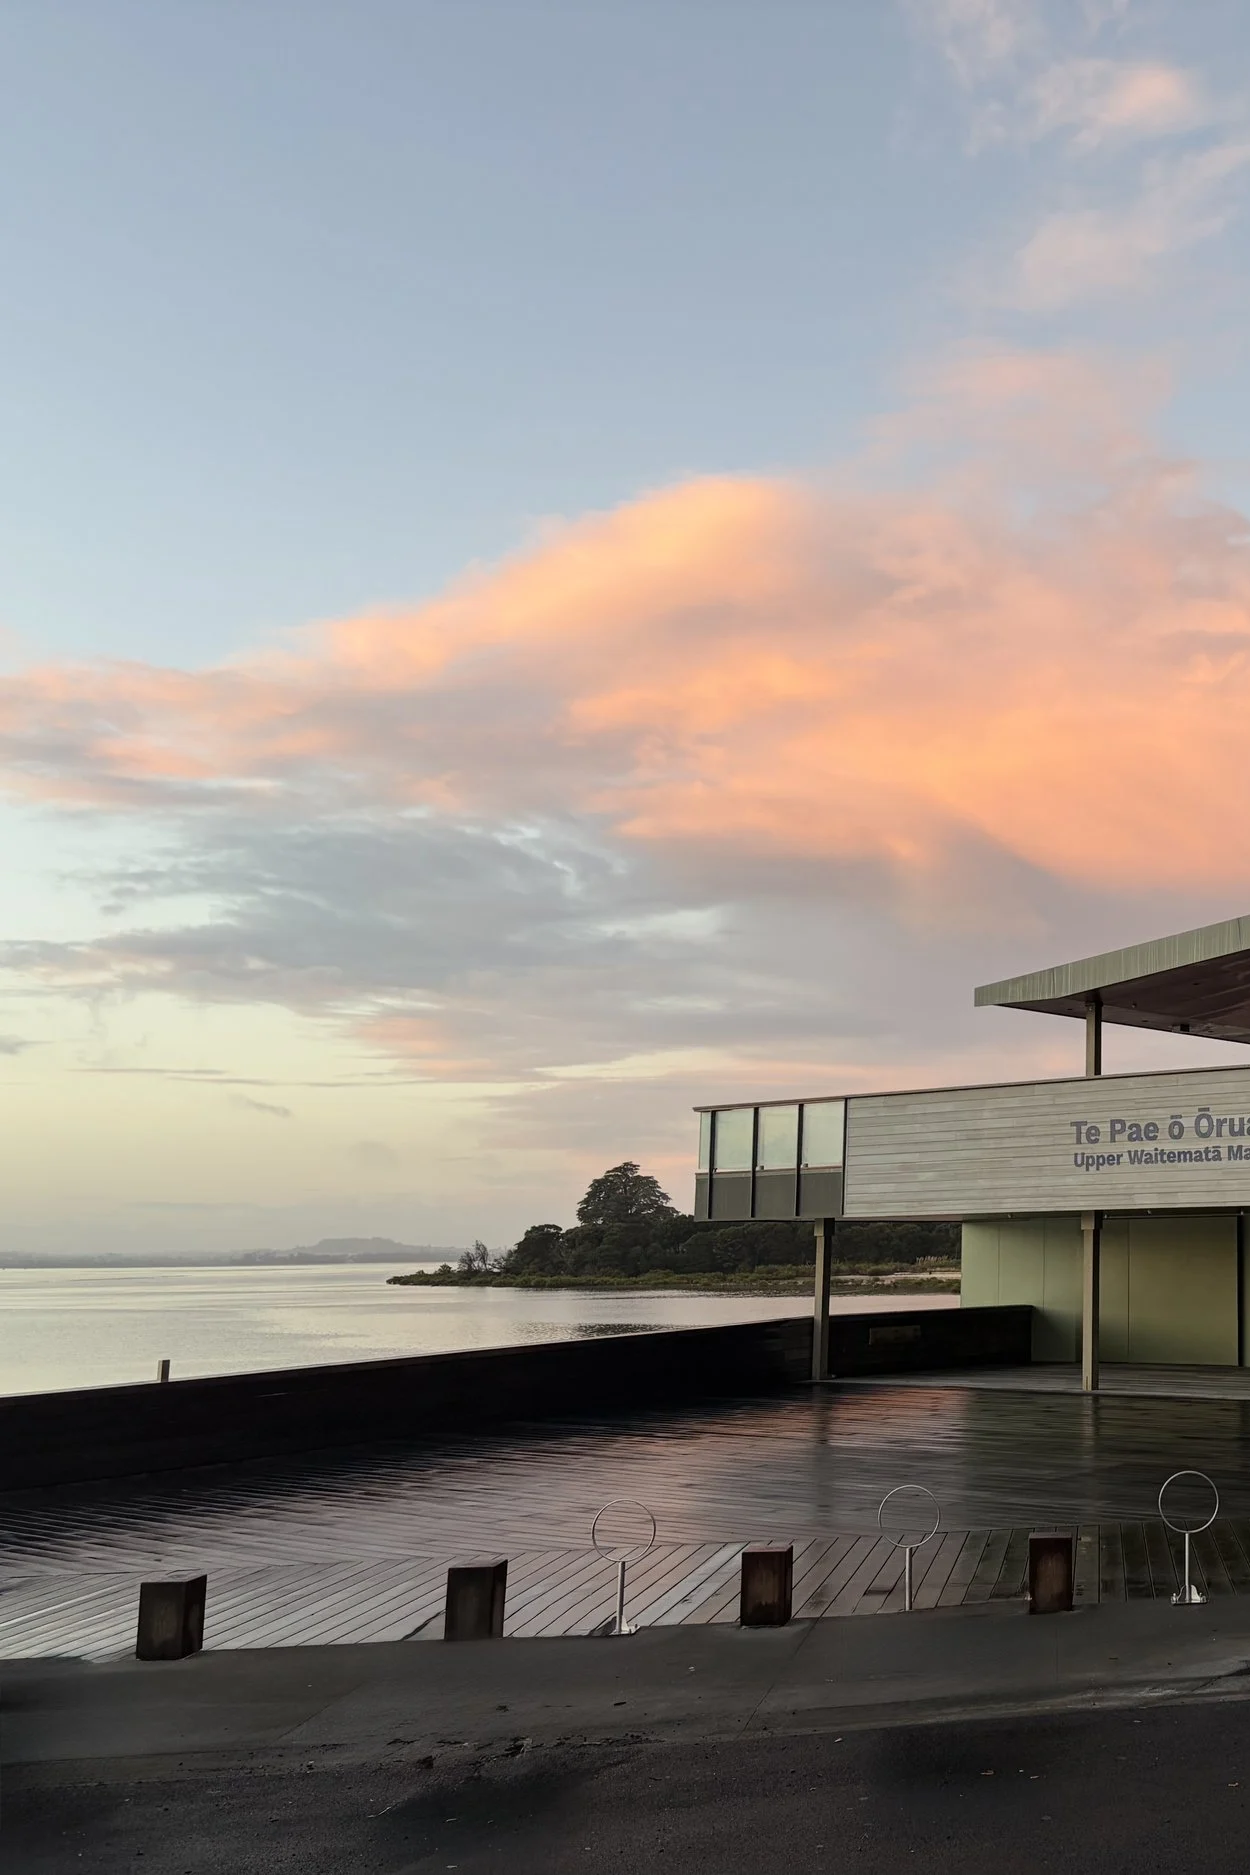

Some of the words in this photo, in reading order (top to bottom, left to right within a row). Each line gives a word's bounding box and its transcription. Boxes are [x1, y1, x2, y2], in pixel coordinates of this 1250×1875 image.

[1070, 1120, 1100, 1145] Te
[1109, 1118, 1160, 1143] Pae
[1168, 1114, 1185, 1140] ō
[1073, 1152, 1123, 1172] Upper
[1128, 1146, 1222, 1165] Waitematā
